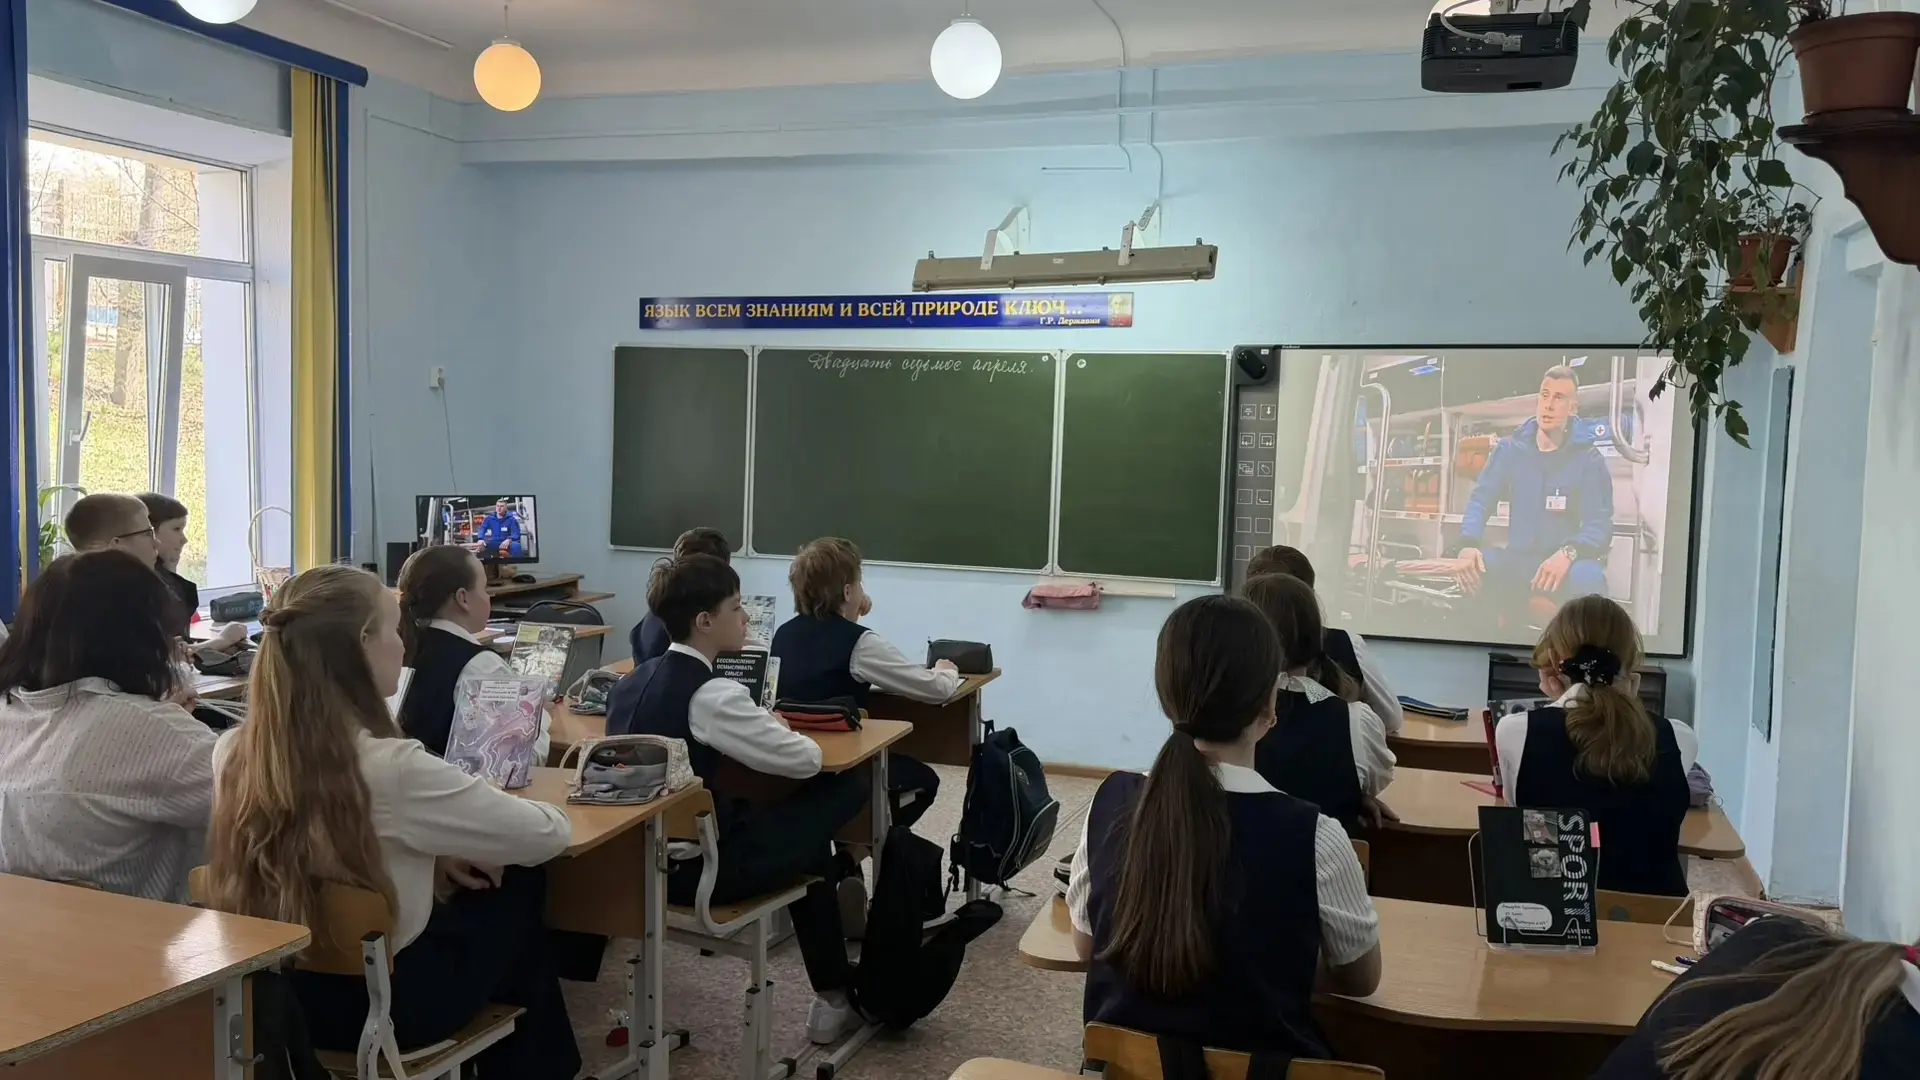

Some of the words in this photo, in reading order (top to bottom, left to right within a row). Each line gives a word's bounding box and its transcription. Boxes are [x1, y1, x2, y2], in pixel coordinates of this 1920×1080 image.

[644, 303, 691, 318] ЯЗЫК
[695, 303, 741, 318] ВСЕМ
[746, 303, 834, 318] ЗНАНИЯМ
[840, 303, 852, 317] И
[857, 299, 906, 317] ВСЕЙ
[911, 301, 999, 317] ПРИРОДЕ
[1004, 299, 1082, 316] КЛЮЧ...
[1039, 317, 1056, 325] Г.Р.
[1058, 317, 1101, 326] Державин
[808, 352, 892, 378] Двадцать
[901, 359, 962, 381] седьмое
[1558, 811, 1591, 923] SPORT
